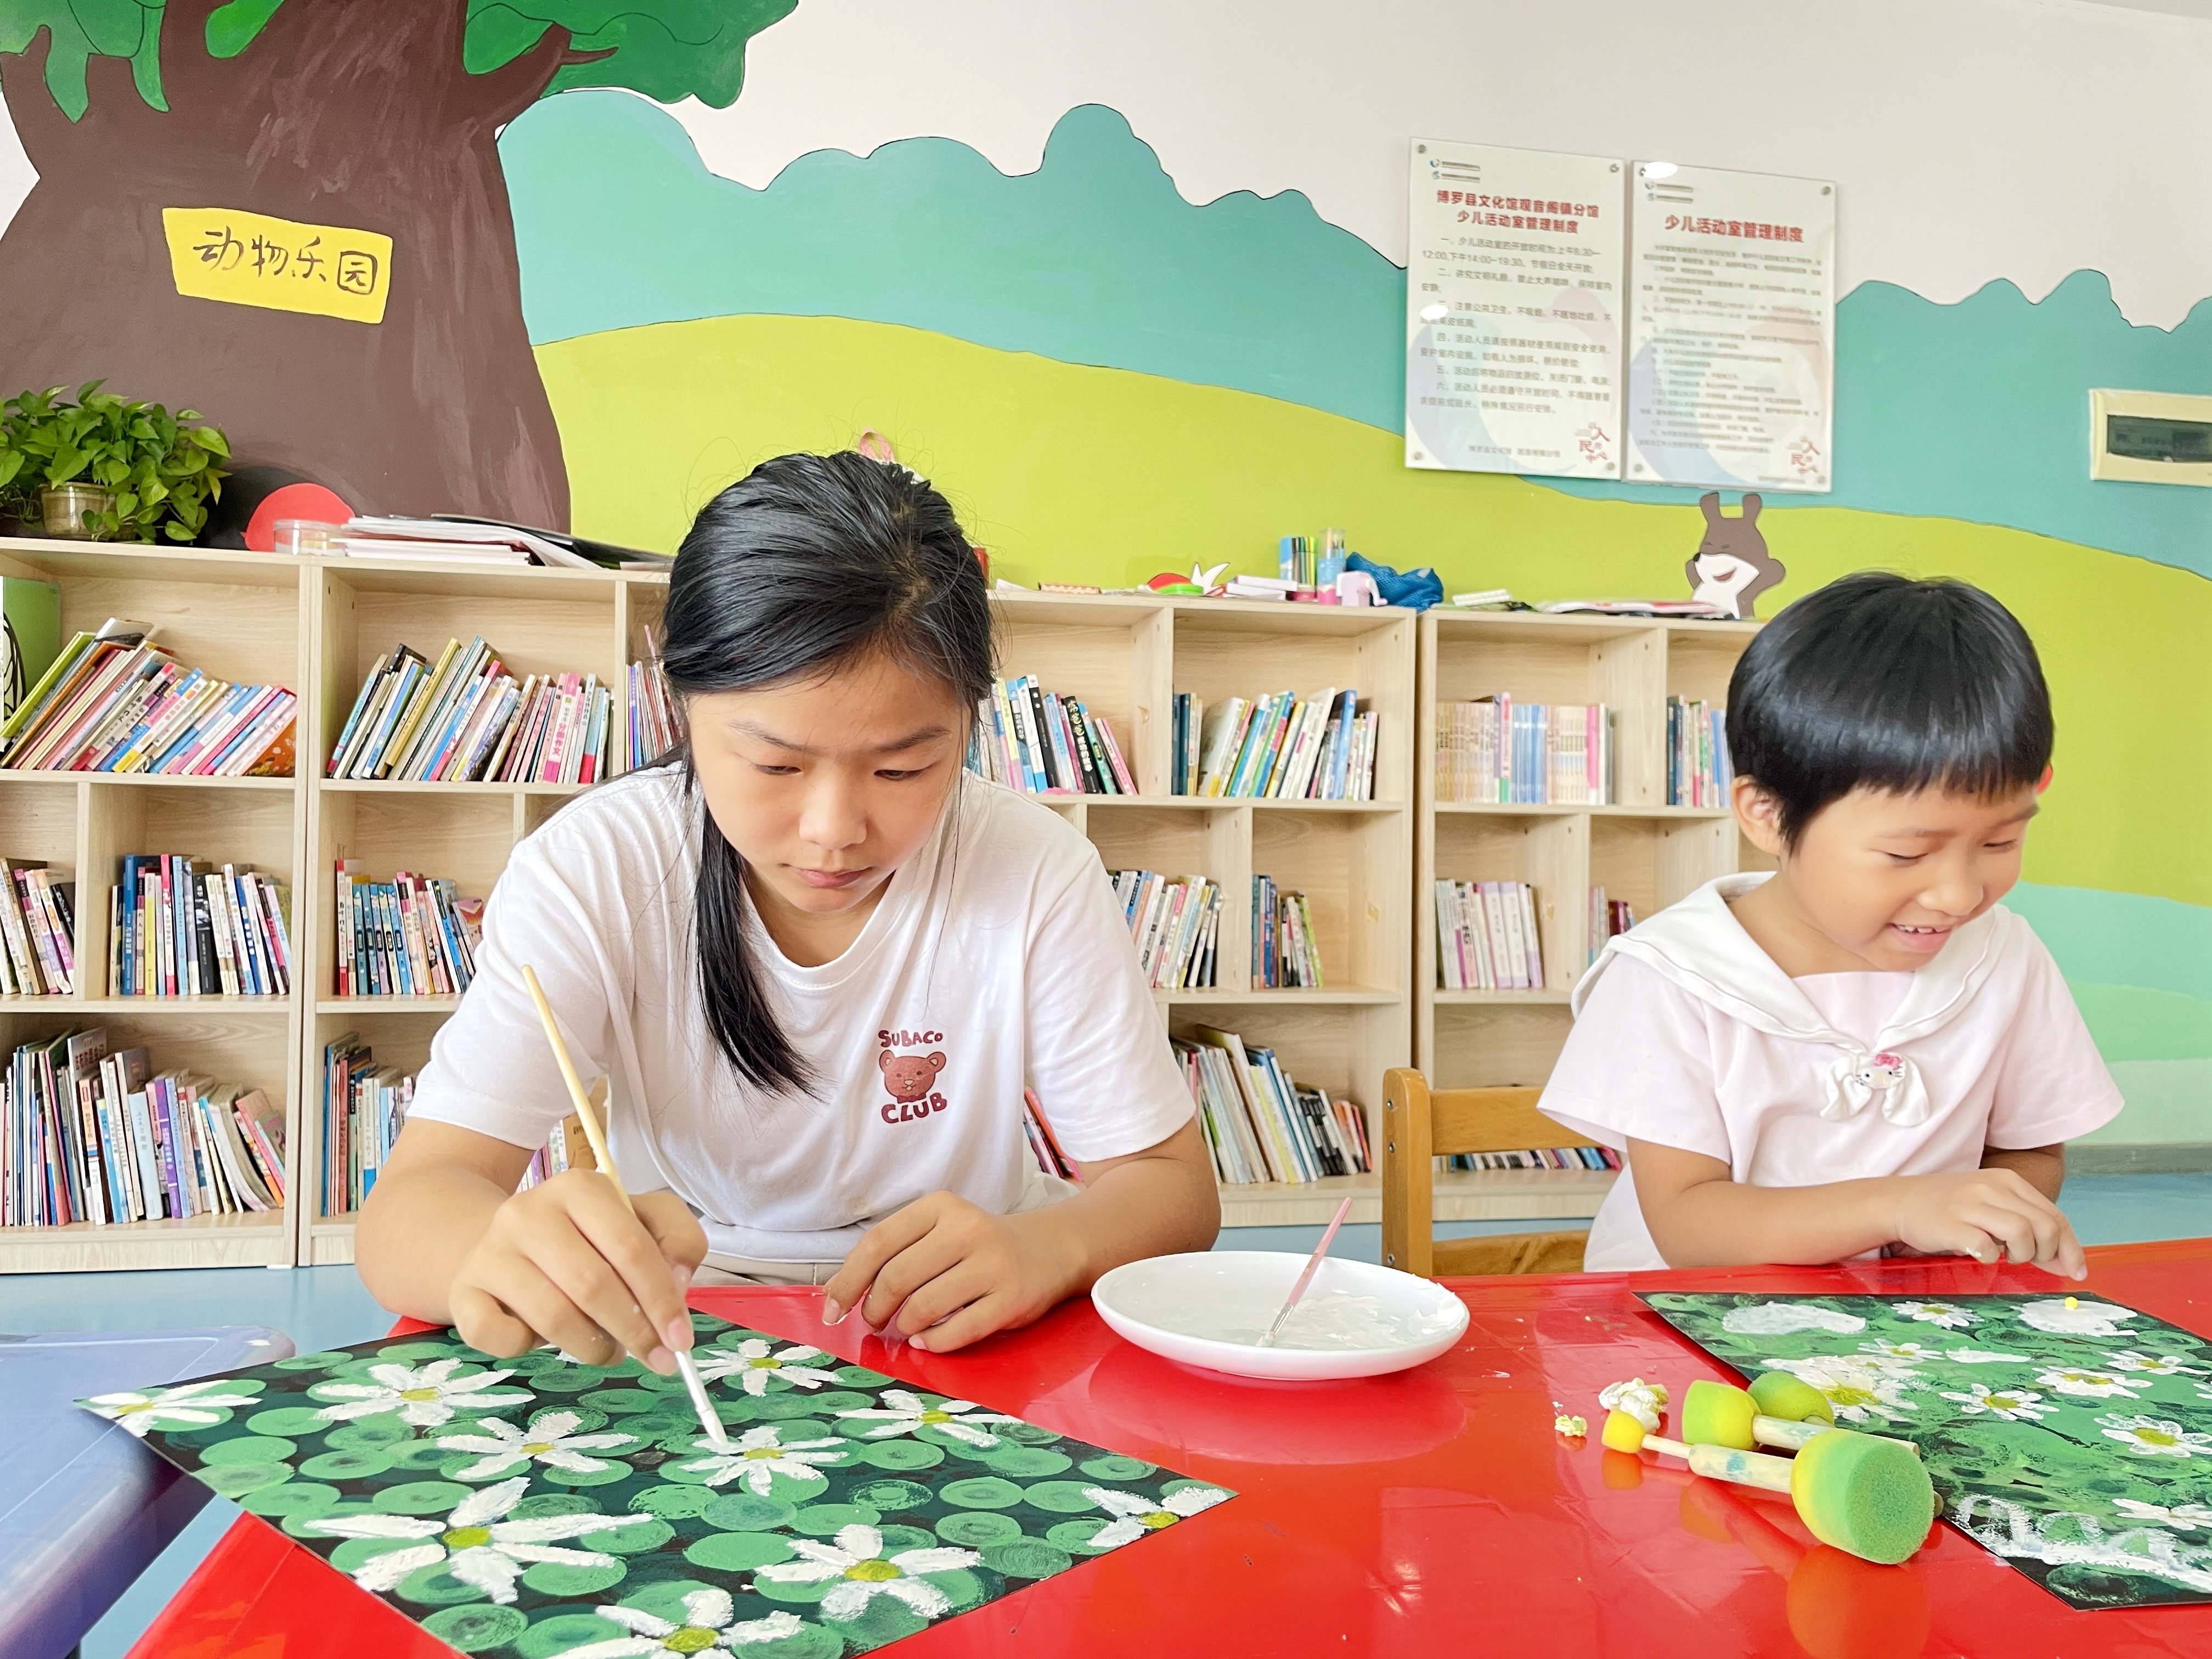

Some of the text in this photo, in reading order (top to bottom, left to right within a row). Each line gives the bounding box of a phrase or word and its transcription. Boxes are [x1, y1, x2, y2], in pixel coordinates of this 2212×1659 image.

[1437, 190, 1600, 218] 博罗县文化馆观音阁镇分馆
[1457, 210, 1579, 234] 少儿活动室管理制度
[1664, 215, 1804, 243] 少儿活动室管理制度
[194, 225, 378, 295] 动物乐园
[881, 1092, 947, 1124] CLUB
